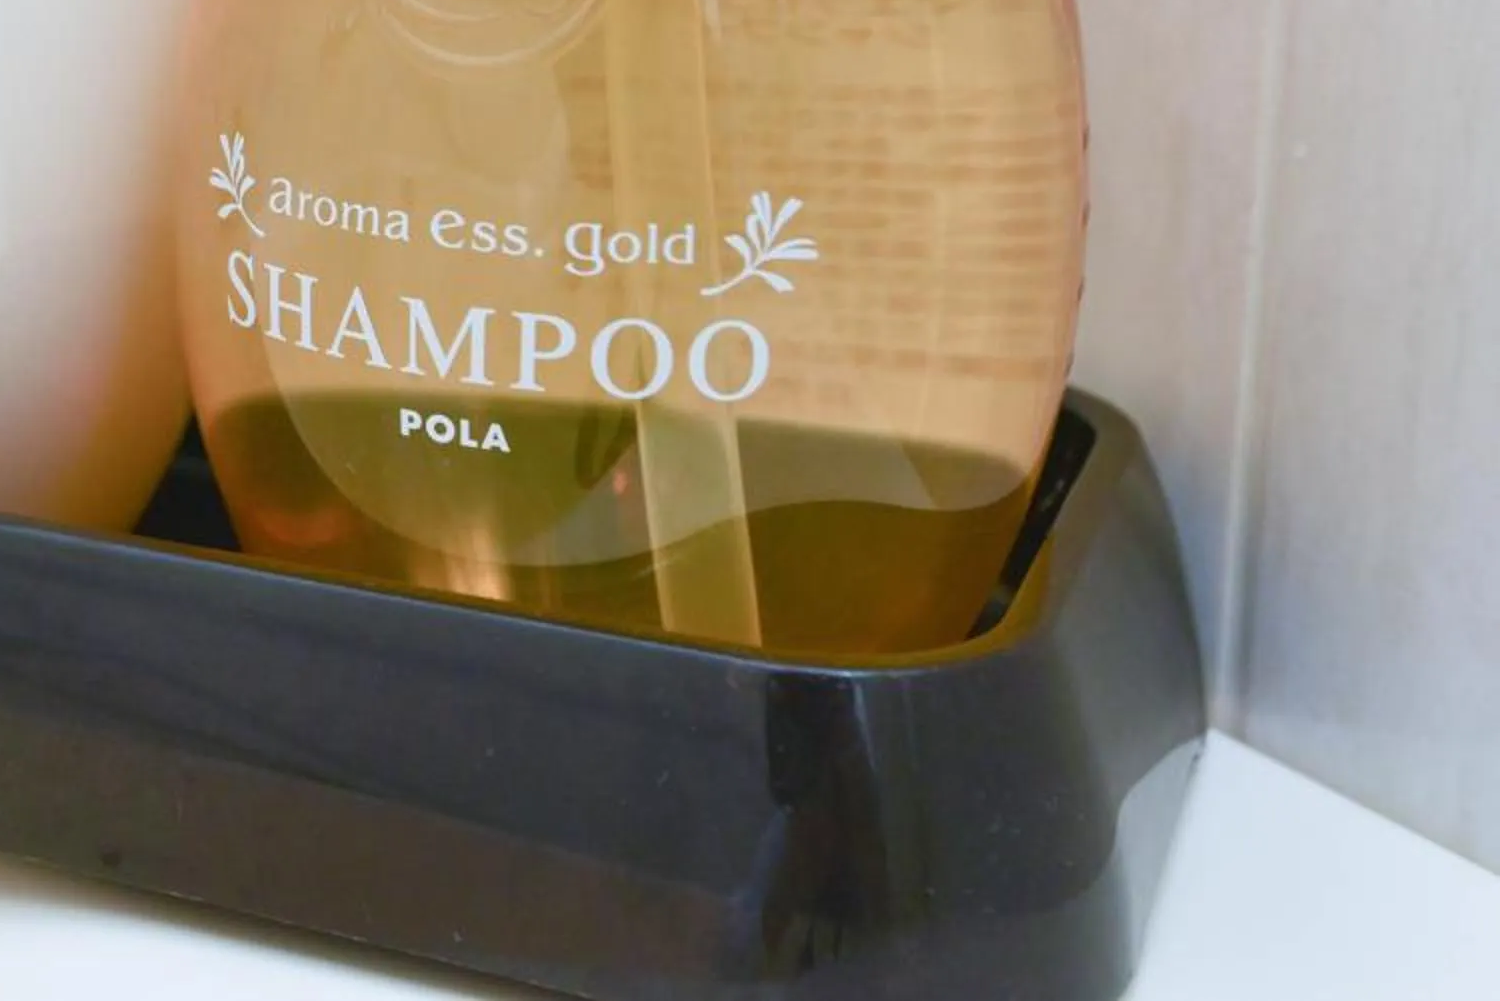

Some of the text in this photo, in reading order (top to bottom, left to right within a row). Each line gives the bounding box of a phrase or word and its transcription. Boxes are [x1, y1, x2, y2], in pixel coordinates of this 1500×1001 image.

[268, 177, 696, 276] aroma ess. gold
[228, 251, 770, 402] SHAMPOO
[400, 409, 511, 453] POLA
